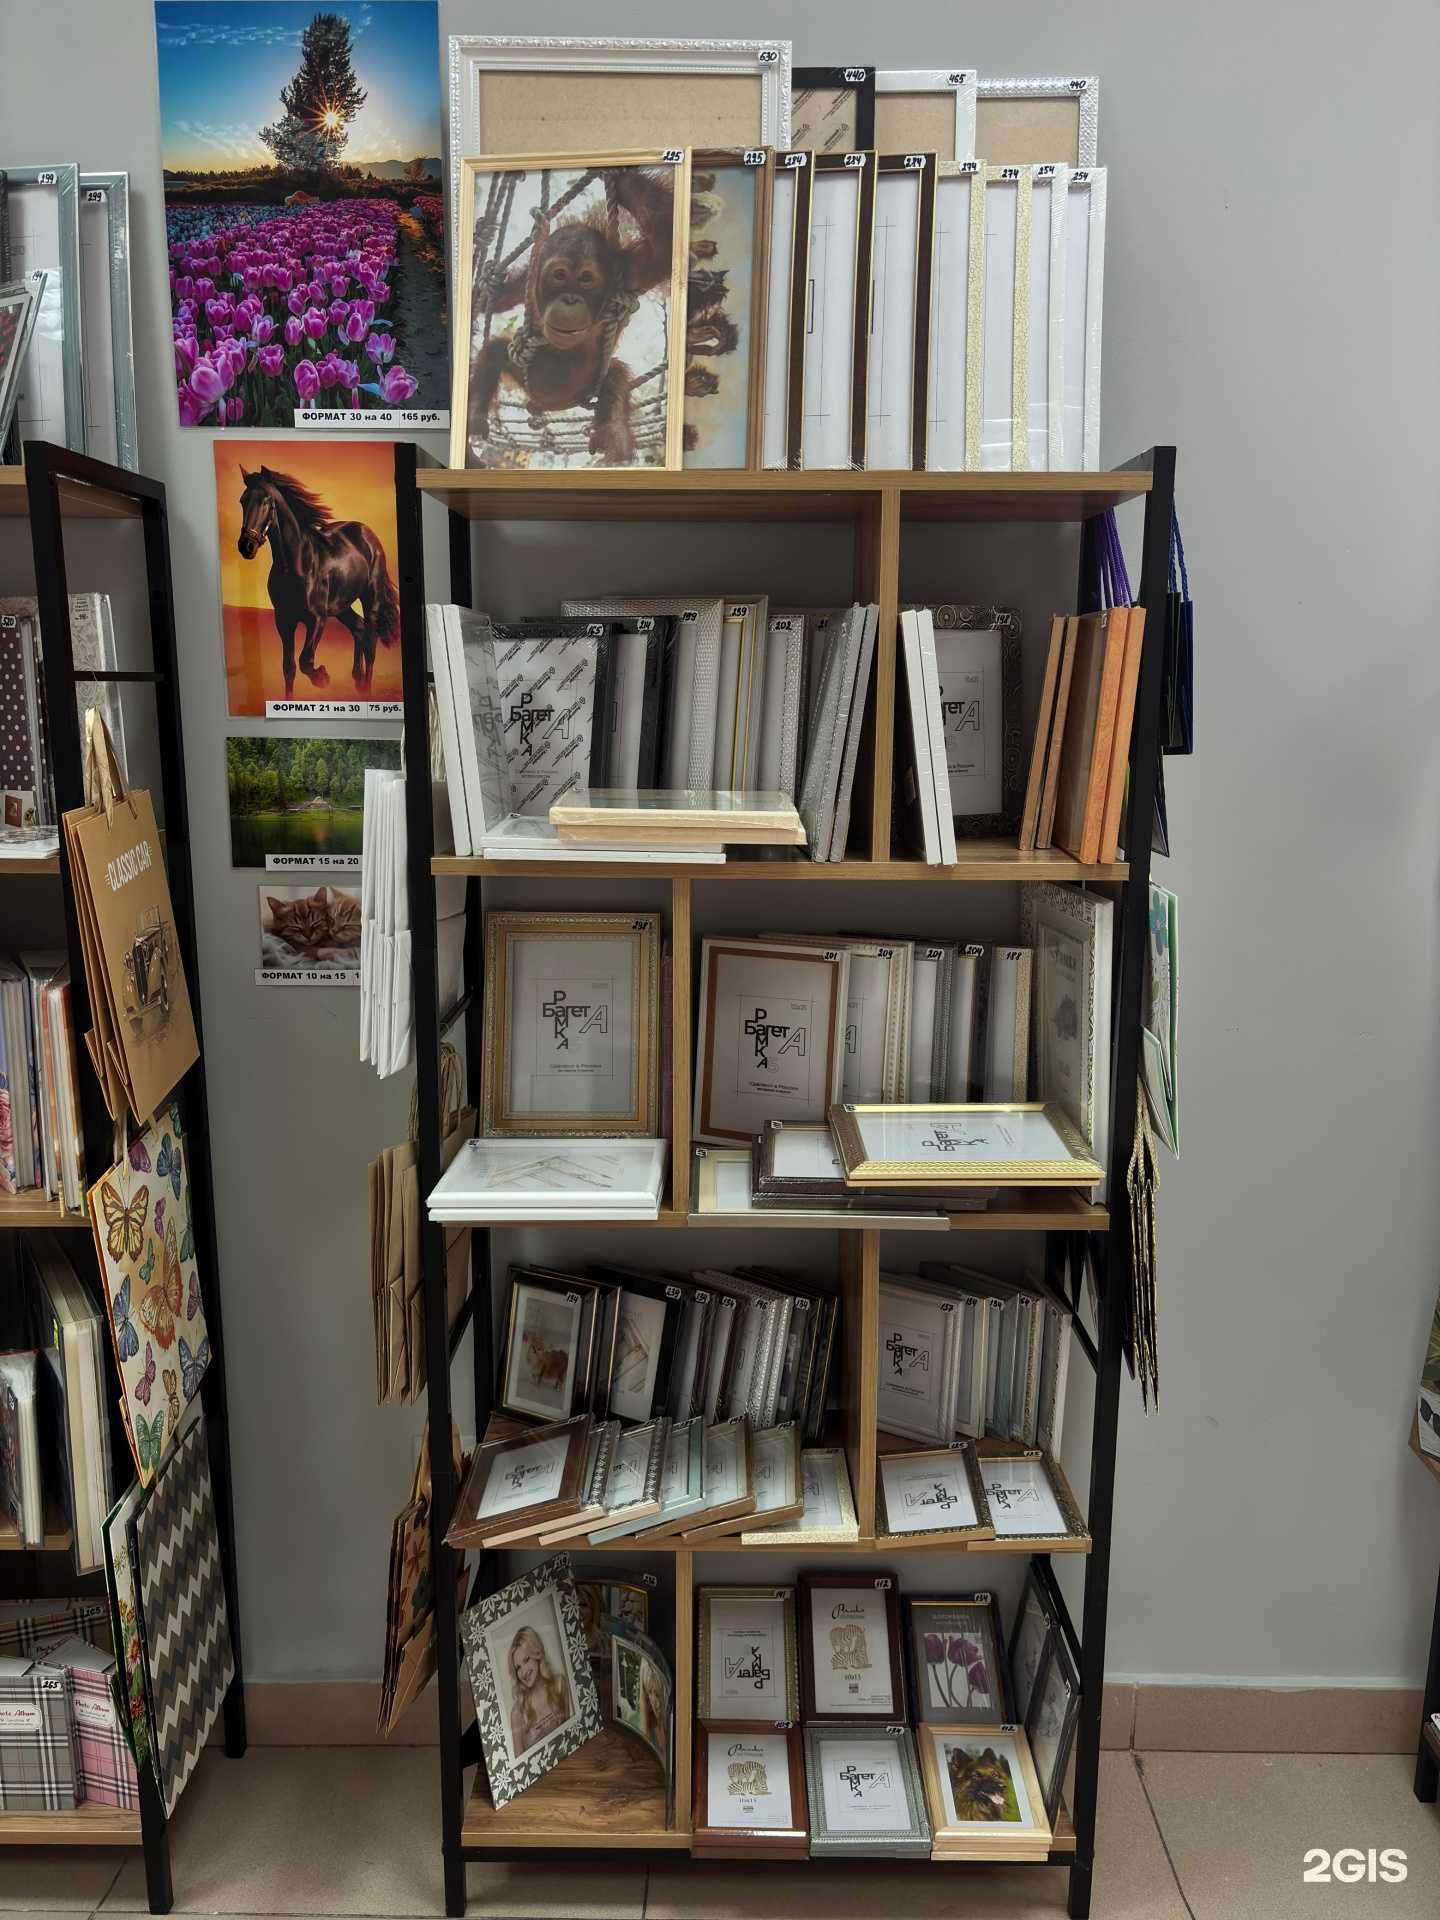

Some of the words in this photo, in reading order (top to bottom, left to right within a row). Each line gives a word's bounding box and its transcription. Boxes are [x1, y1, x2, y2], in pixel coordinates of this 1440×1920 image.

[846, 70, 864, 80] 440
[1069, 80, 1086, 89] 440
[302, 413, 346, 421] ФОРМАТ
[350, 413, 362, 421] 30
[380, 413, 392, 421] 40
[402, 413, 417, 421] 165
[421, 413, 440, 422] руб.
[273, 704, 316, 712] ФОРМАТ
[319, 704, 330, 712] 21
[349, 704, 360, 712] 30
[369, 704, 380, 712] 75
[383, 704, 402, 713] руб.
[273, 857, 315, 865] ФОРМАТ
[319, 857, 330, 865] 15
[348, 857, 359, 865] 20
